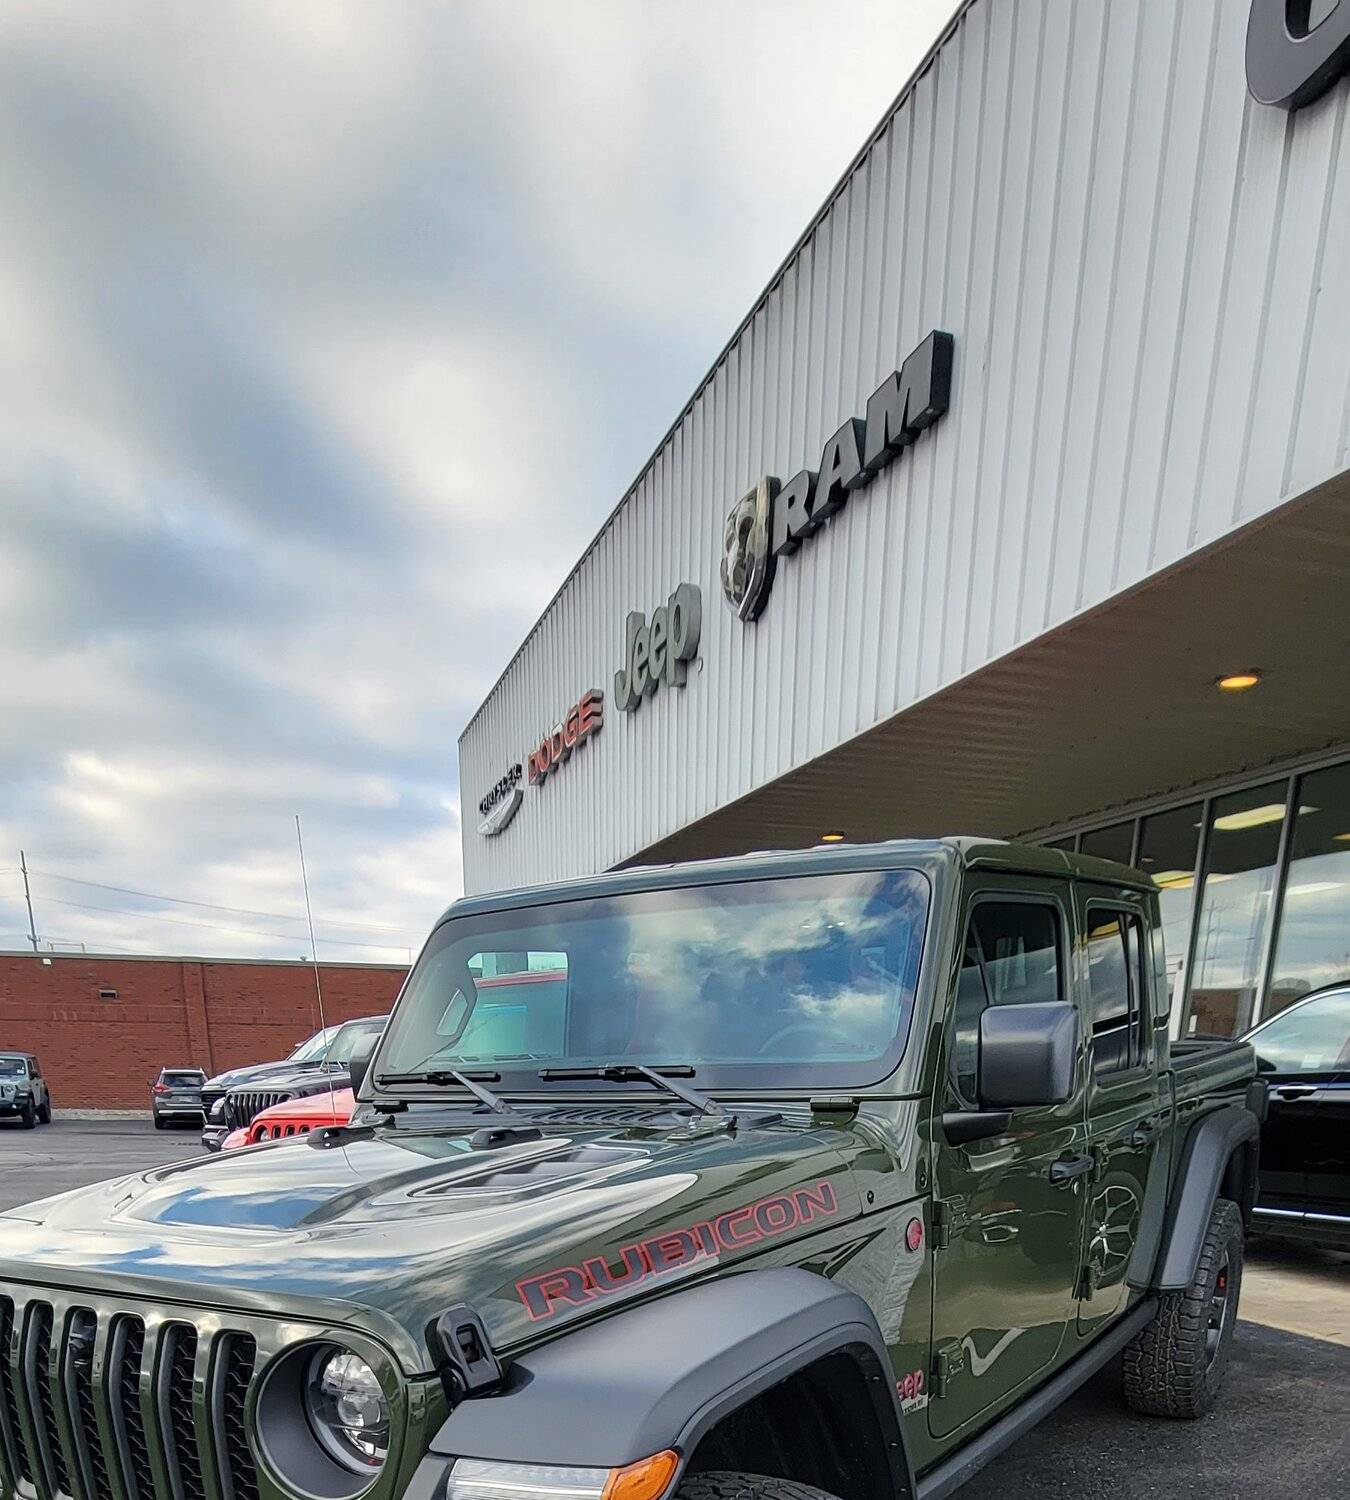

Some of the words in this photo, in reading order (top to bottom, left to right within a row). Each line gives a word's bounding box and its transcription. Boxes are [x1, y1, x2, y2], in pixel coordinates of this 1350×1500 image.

[772, 330, 953, 556] RAM
[614, 582, 701, 712] Jeep
[527, 689, 604, 786] DODGE
[515, 1180, 838, 1321] RUBICON
[896, 1369, 924, 1400] eep
